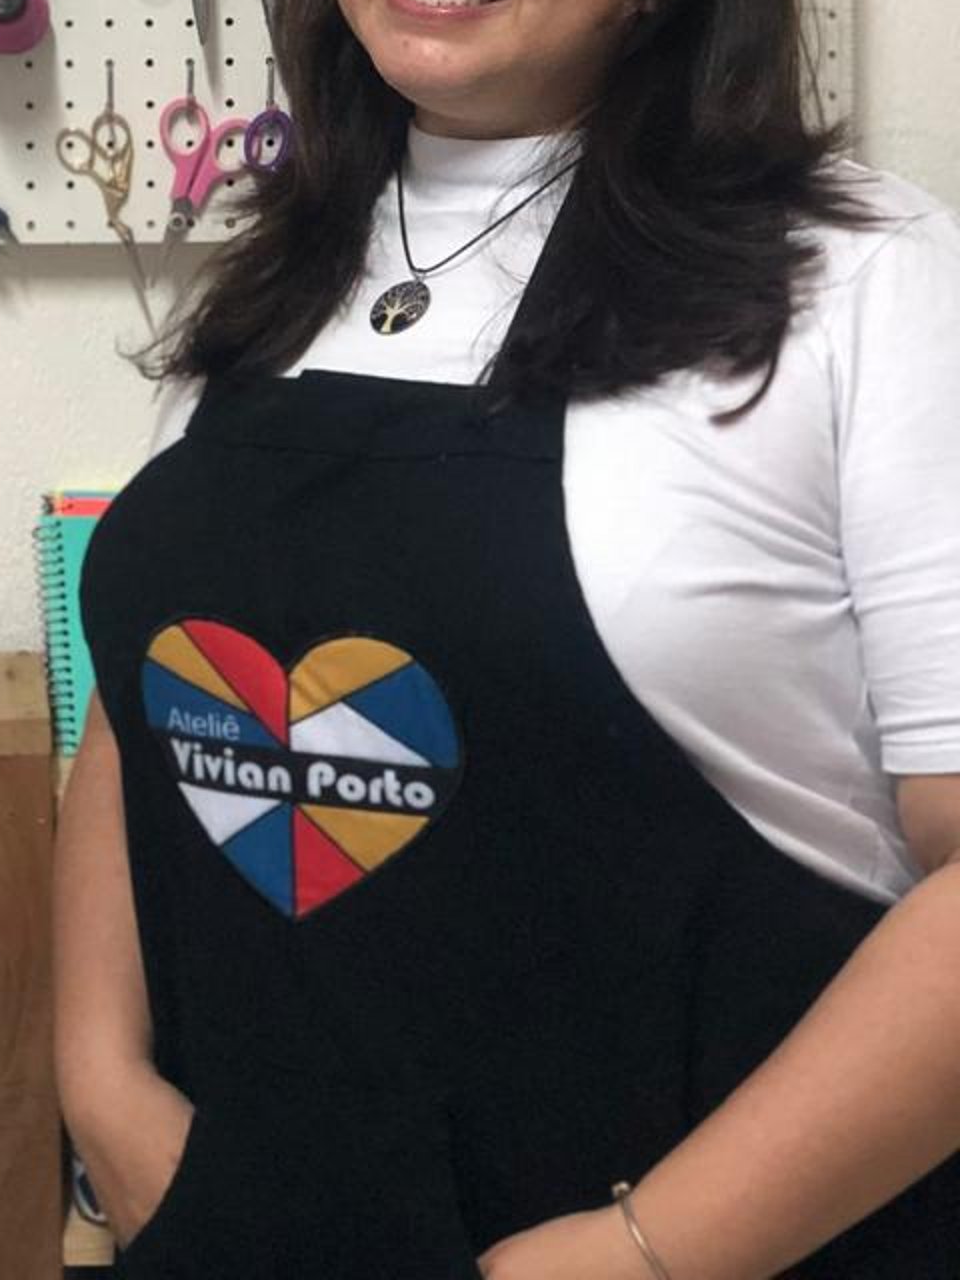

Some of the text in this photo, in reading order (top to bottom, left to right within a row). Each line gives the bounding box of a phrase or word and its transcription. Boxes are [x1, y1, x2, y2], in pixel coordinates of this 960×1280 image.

[167, 708, 240, 740] Ateliê
[170, 738, 436, 809] Vivian Porto
